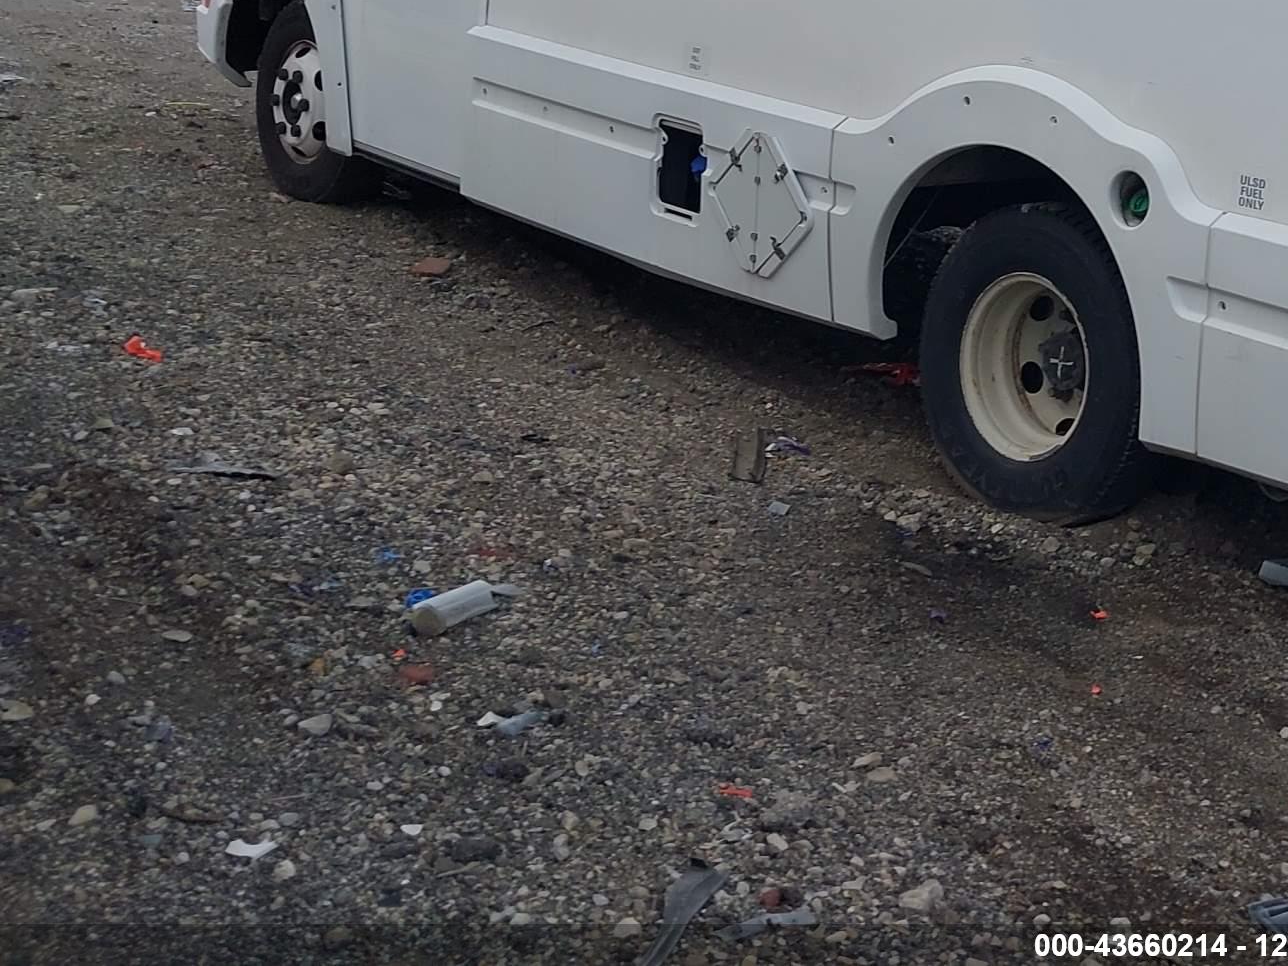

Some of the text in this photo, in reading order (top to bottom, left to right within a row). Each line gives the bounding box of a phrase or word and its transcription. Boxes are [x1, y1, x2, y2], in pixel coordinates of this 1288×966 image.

[1240, 174, 1266, 189] ULSD
[1240, 186, 1264, 200] FUEL
[1238, 197, 1264, 211] ONLY
